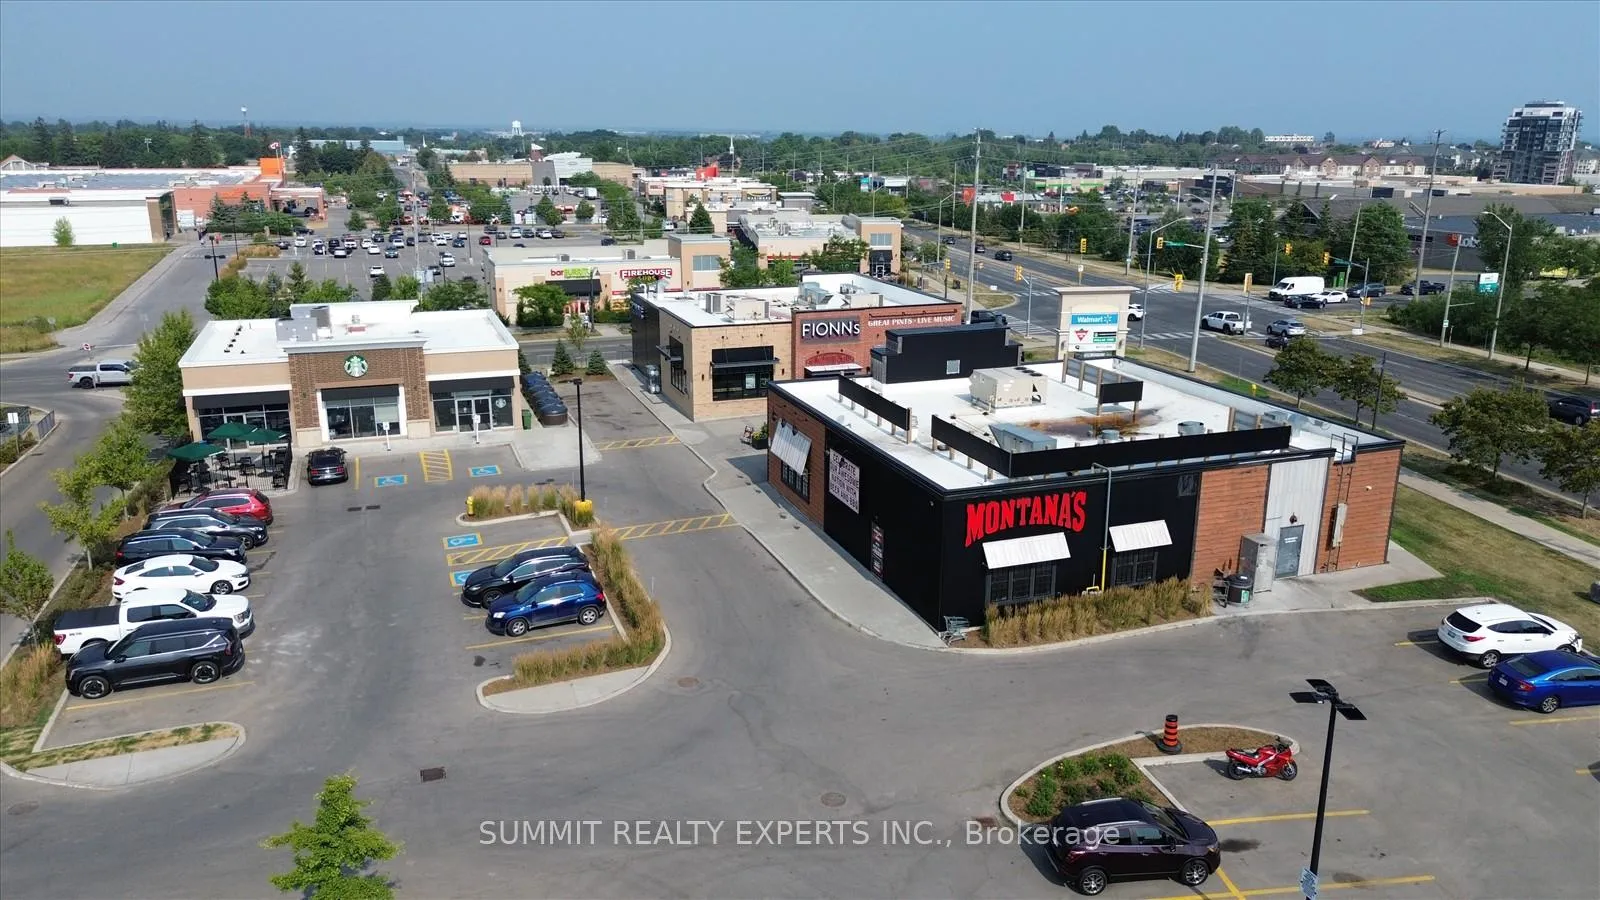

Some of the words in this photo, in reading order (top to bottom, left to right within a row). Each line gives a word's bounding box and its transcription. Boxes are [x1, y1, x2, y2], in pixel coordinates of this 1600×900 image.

[622, 268, 672, 279] FIREHOUSE
[868, 318, 889, 327] GREAT
[891, 317, 912, 326] PINTS
[917, 316, 932, 324] LIVE
[934, 315, 955, 323] MUSIC
[965, 491, 1086, 547] MONTANA'S
